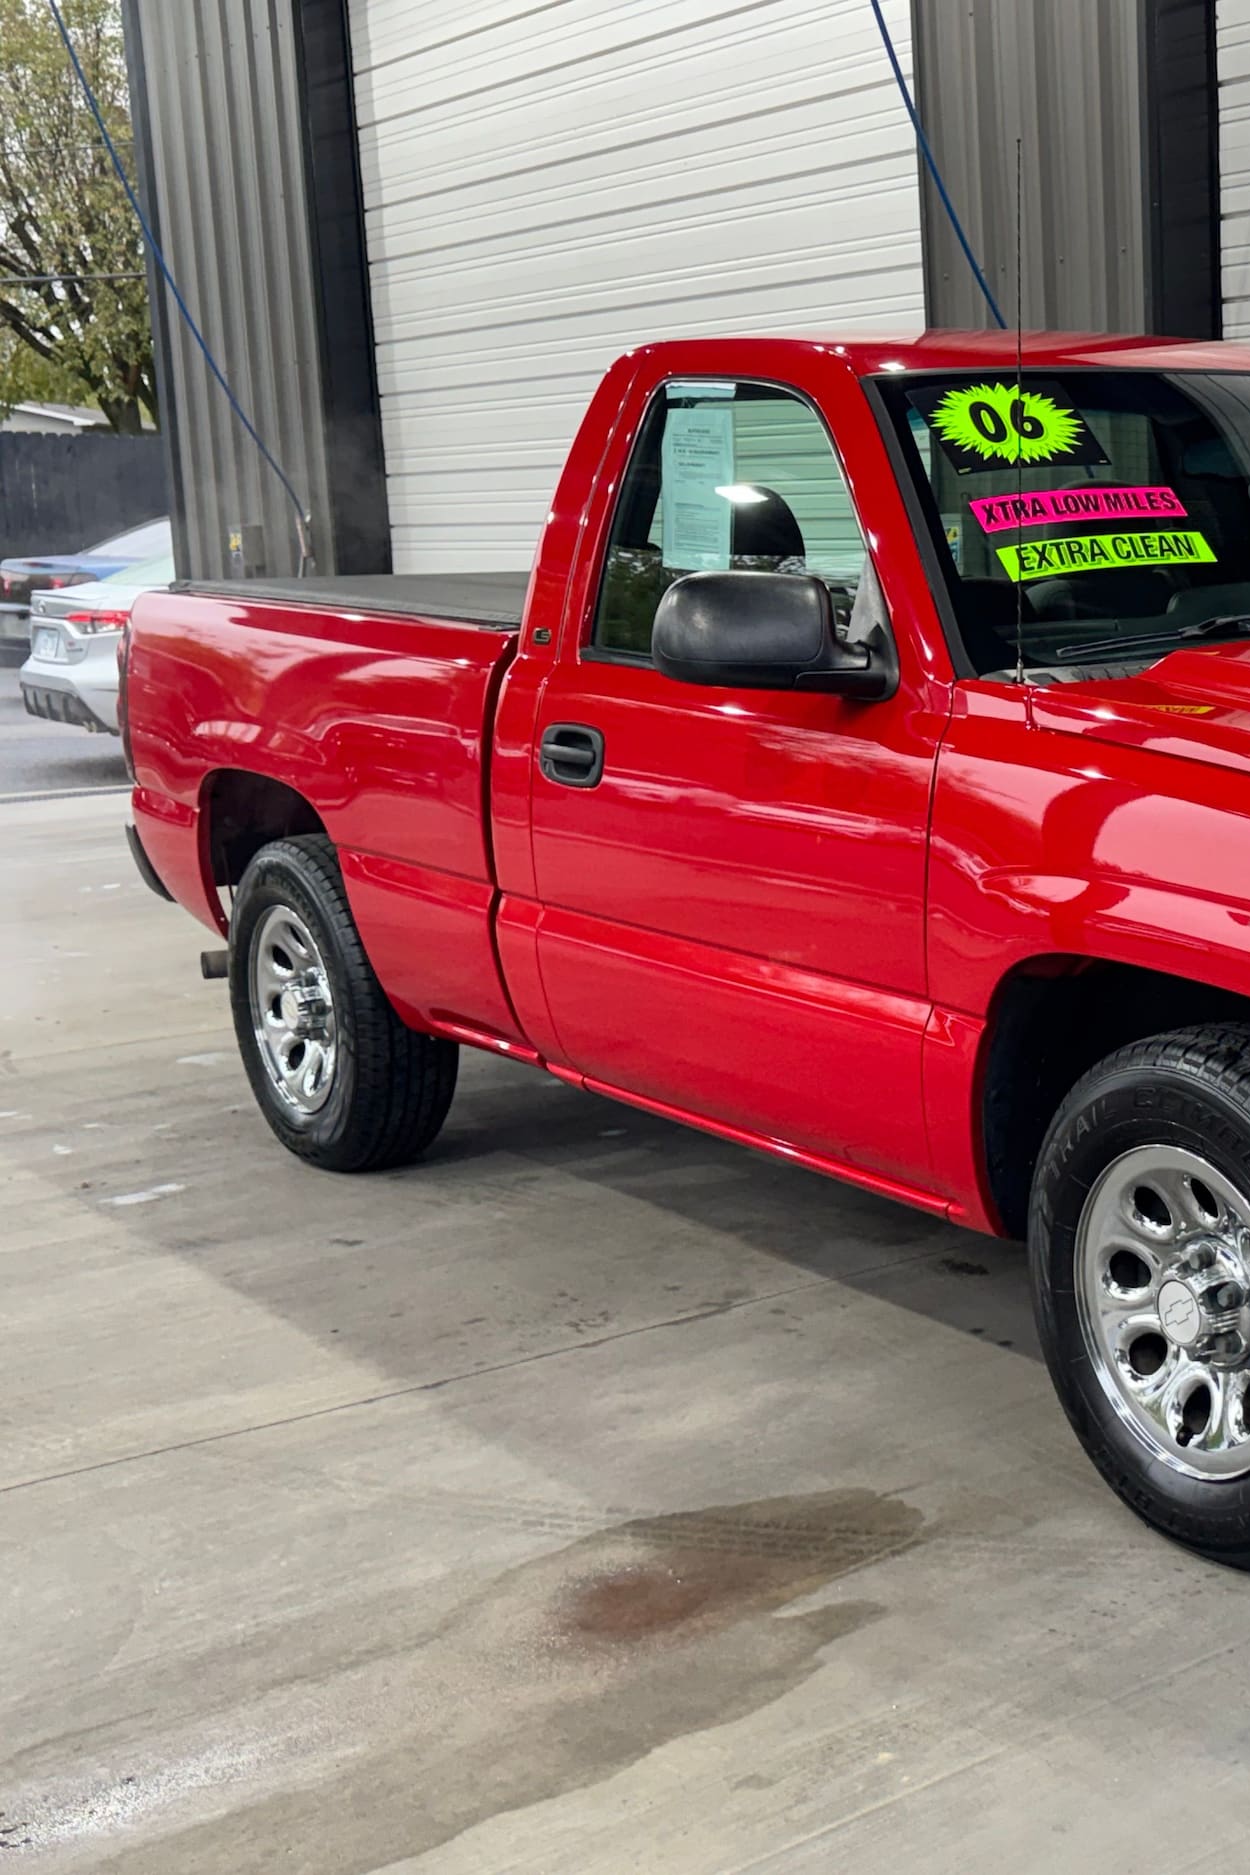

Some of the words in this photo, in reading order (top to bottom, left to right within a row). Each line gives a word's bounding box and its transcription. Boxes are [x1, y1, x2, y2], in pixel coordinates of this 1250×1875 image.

[968, 399, 1045, 443] 06
[983, 502, 1047, 525] XTRA
[1052, 495, 1099, 516] LOW
[1100, 491, 1177, 512] MILES
[1017, 540, 1108, 573] EXTRA
[1112, 533, 1198, 562] CLEAN
